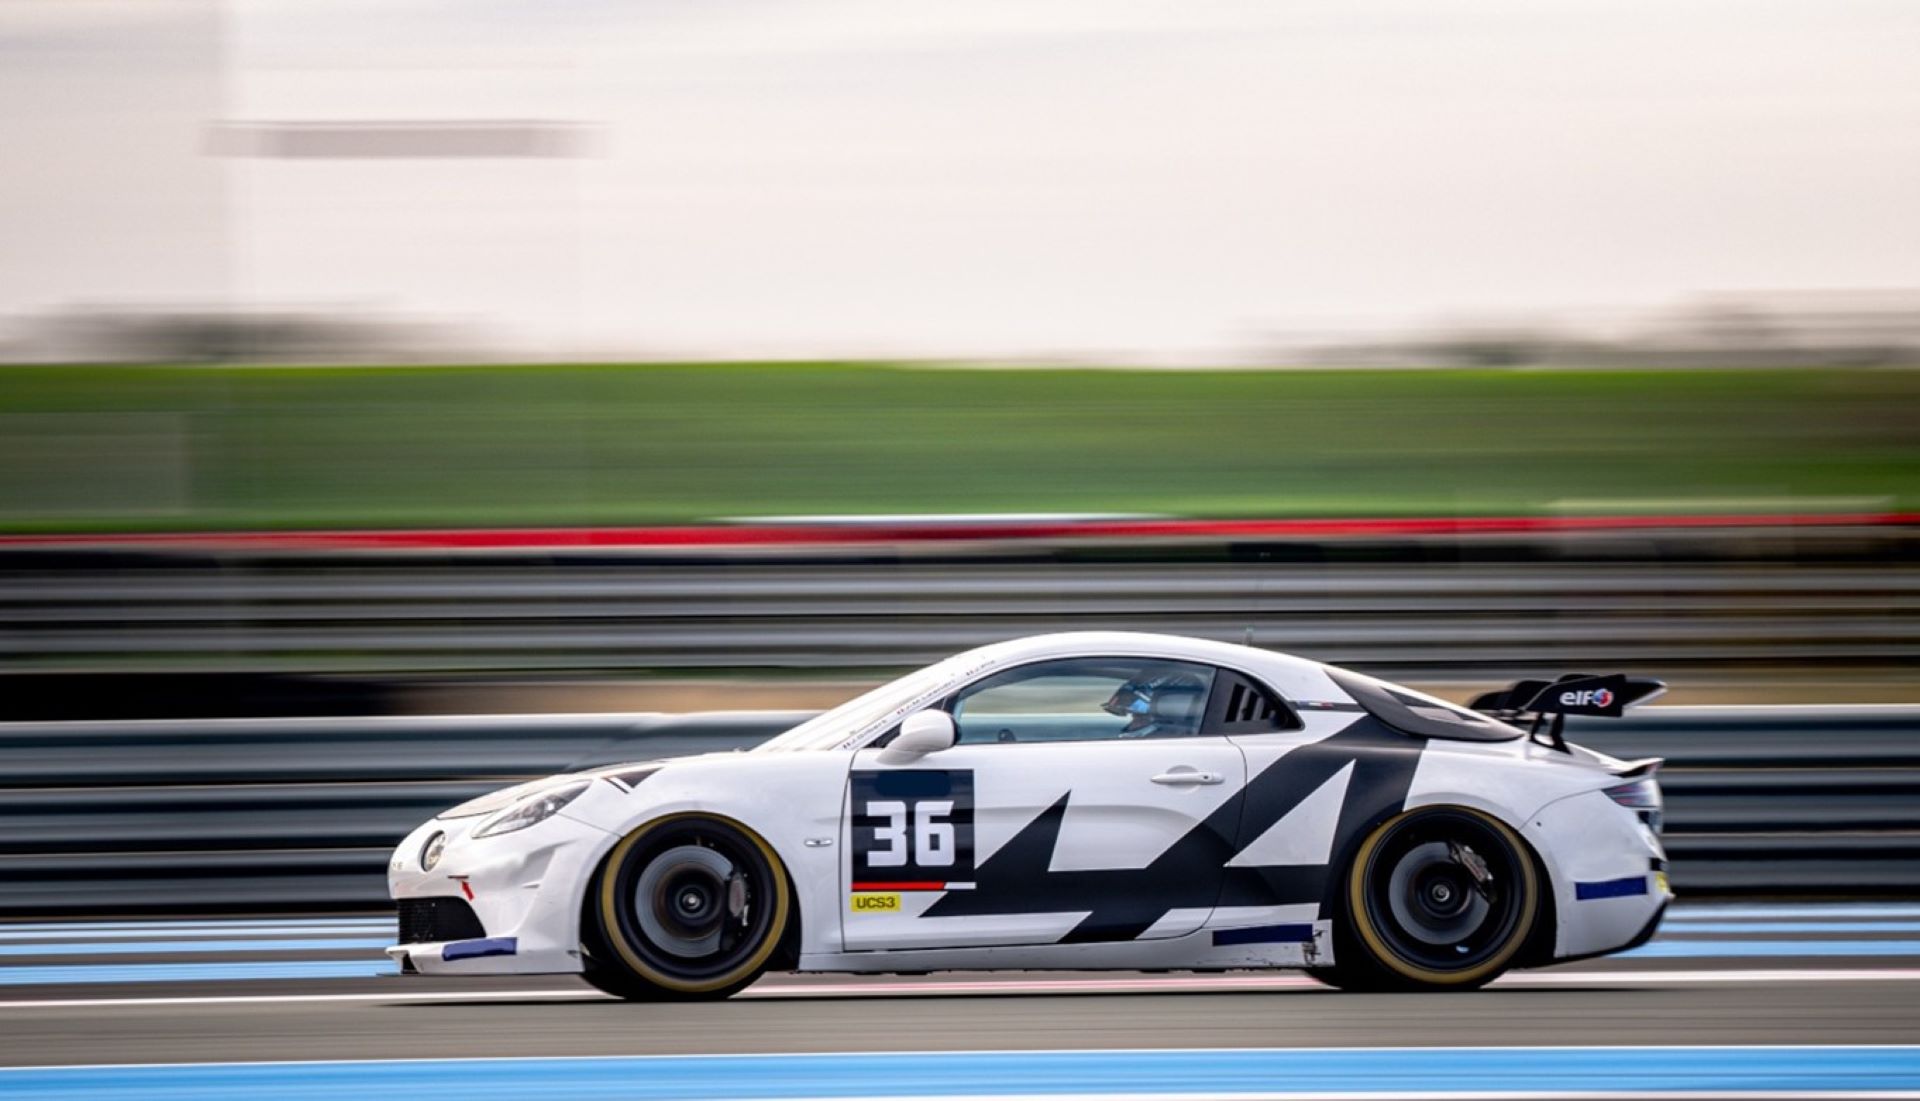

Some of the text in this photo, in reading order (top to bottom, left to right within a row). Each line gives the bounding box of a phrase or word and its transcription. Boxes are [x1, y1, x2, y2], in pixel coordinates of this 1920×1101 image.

[1560, 690, 1594, 706] elf
[866, 801, 955, 867] 36
[856, 896, 896, 909] UCS3
